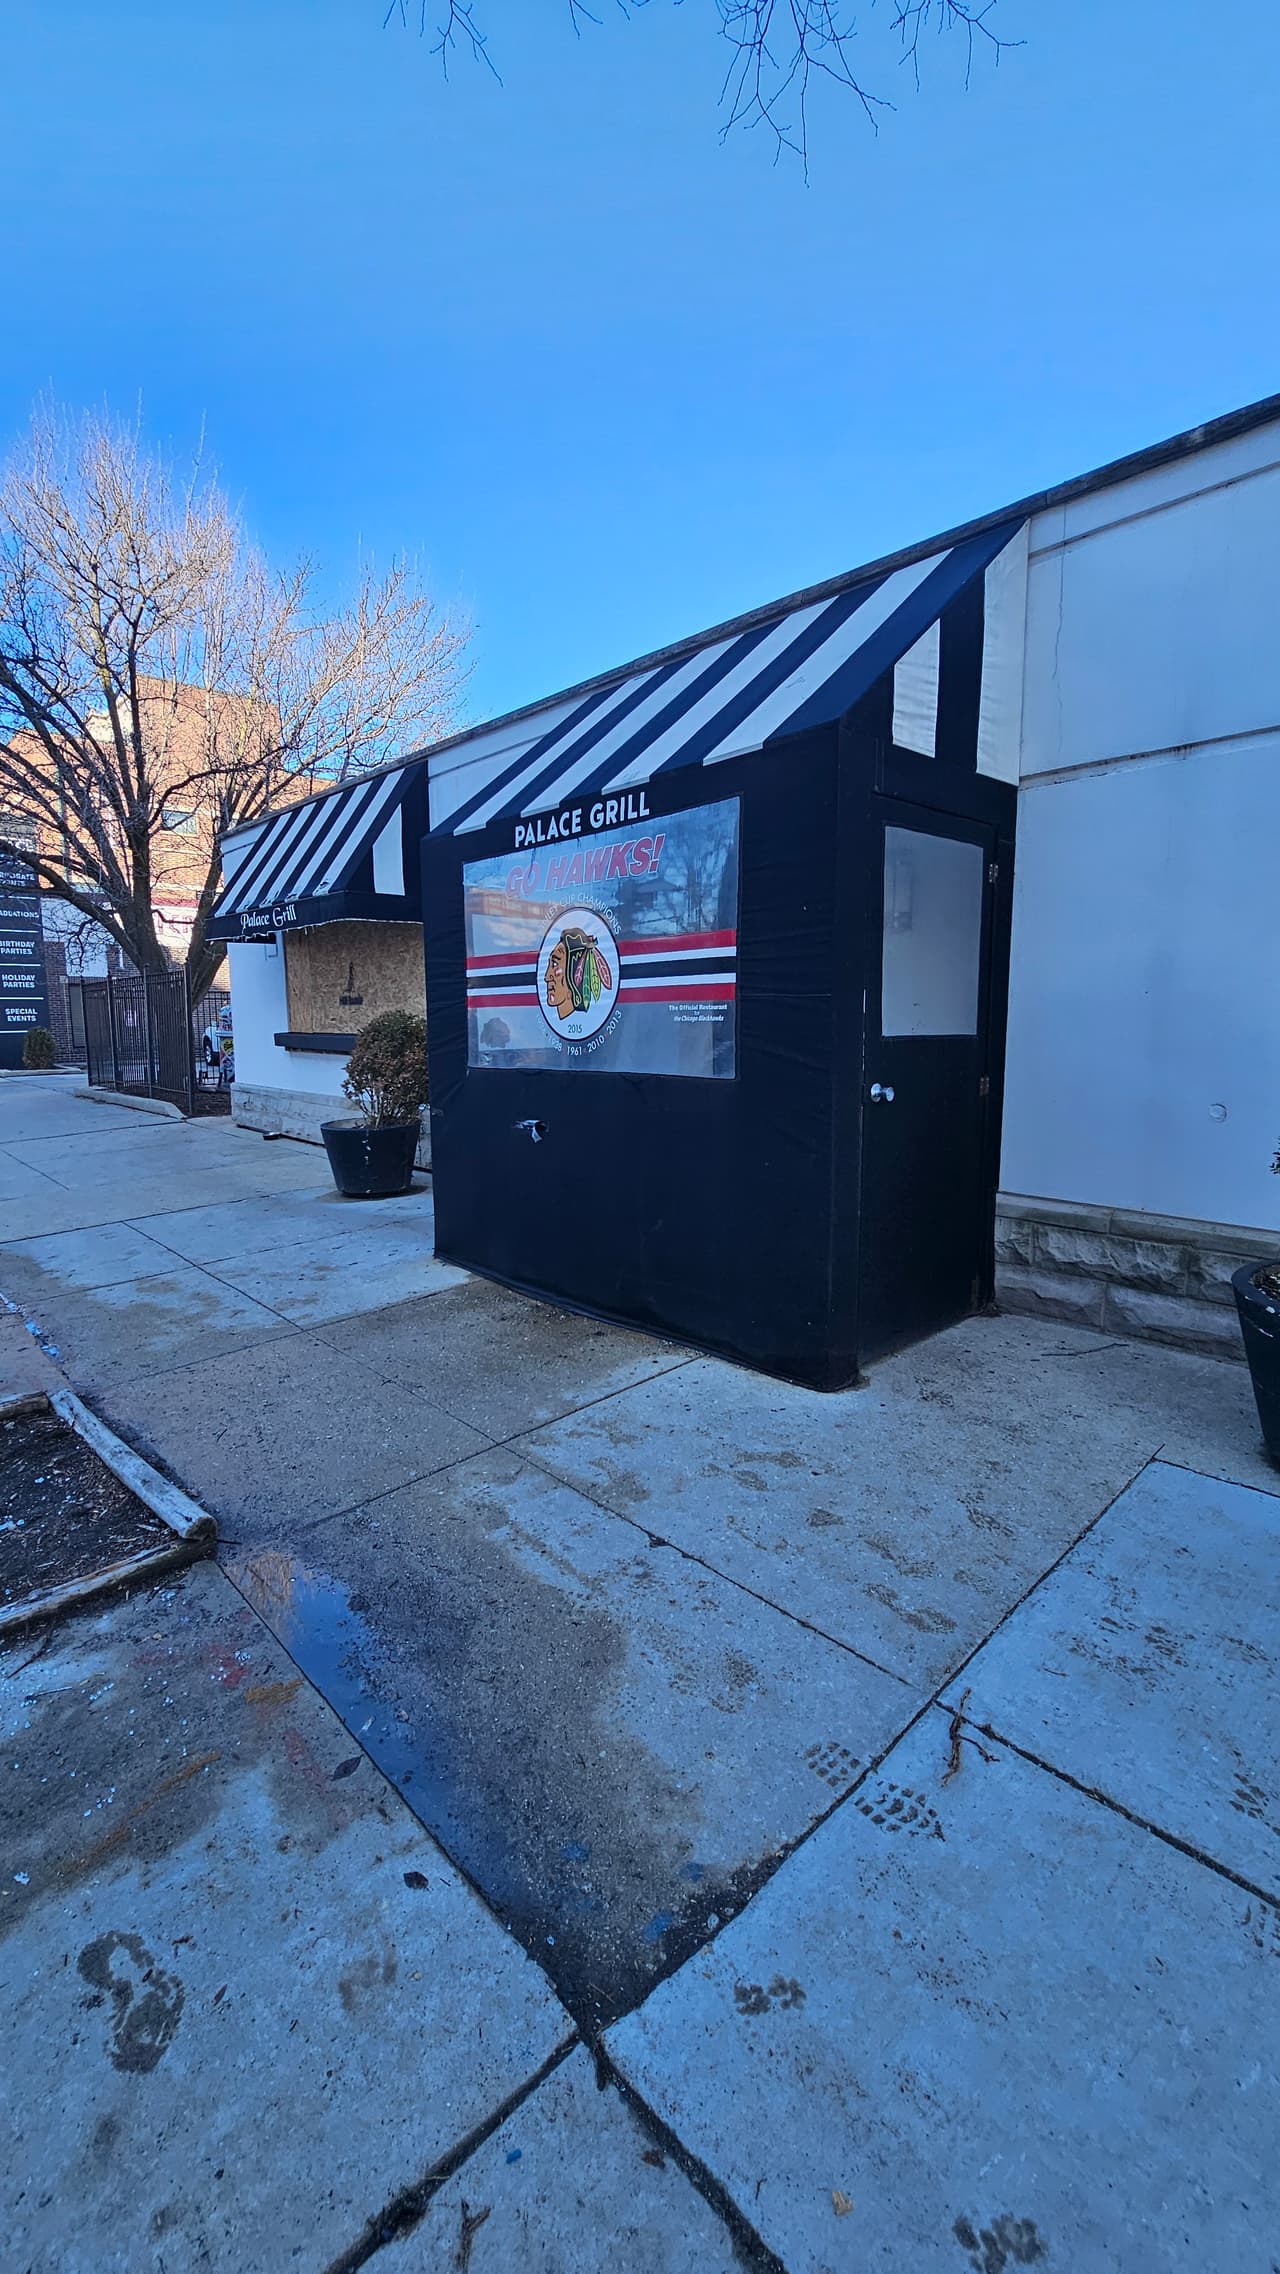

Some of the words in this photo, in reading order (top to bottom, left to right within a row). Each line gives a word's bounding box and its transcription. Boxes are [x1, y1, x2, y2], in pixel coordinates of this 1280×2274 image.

[514, 808, 582, 848] PALACE
[589, 791, 650, 829] GRILL
[505, 861, 541, 898] GO
[544, 833, 666, 891] HAWKS!
[240, 913, 270, 929] Palace
[272, 904, 297, 927] Grill
[577, 892, 622, 935] CHAMPIONS
[0, 947, 33, 955] PARTIES
[1, 974, 36, 982] HOLIDAY
[3, 981, 36, 989] PARTIES
[5, 1008, 38, 1016] SPECIAL
[567, 1024, 583, 1034] 2015
[567, 1046, 583, 1056] 1961
[587, 1034, 605, 1053] 2010
[606, 1010, 622, 1035] 2013
